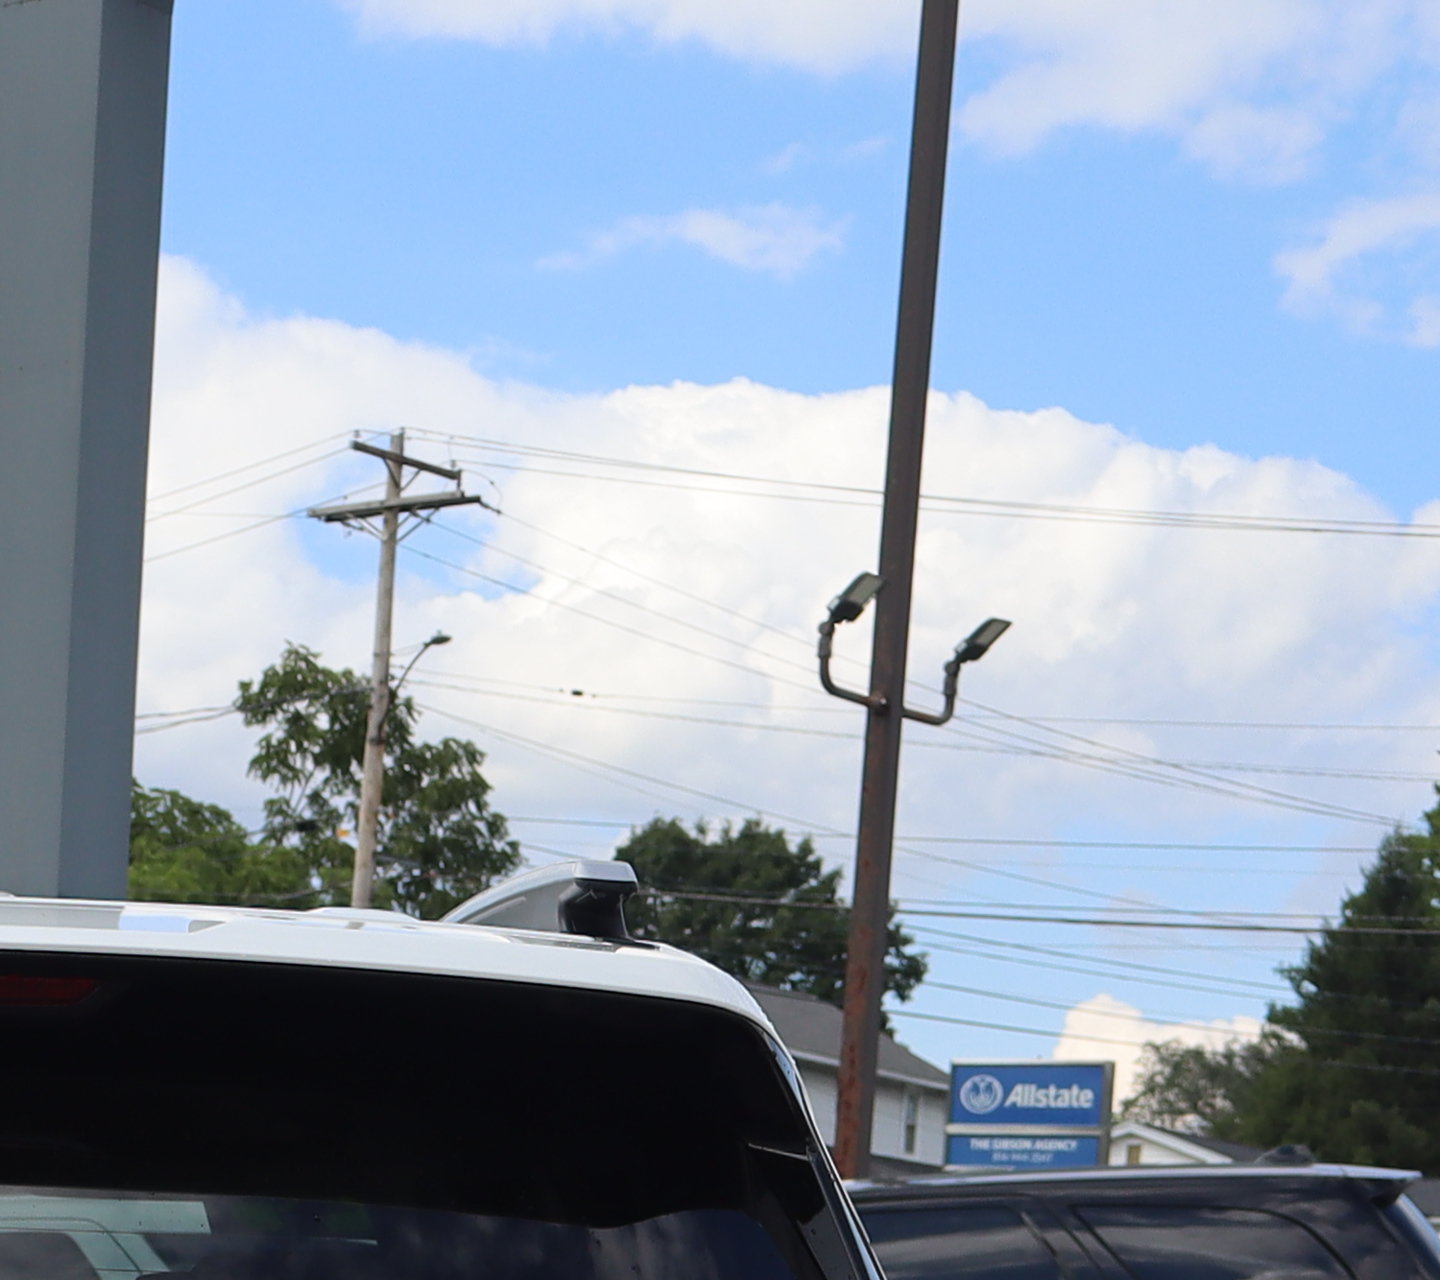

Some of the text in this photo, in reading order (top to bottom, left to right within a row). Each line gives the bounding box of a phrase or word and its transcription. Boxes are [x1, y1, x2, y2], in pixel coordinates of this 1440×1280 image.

[1004, 1083, 1094, 1109] Allstate
[970, 1137, 990, 1150] THE
[1033, 1138, 1079, 1151] AGENCY
